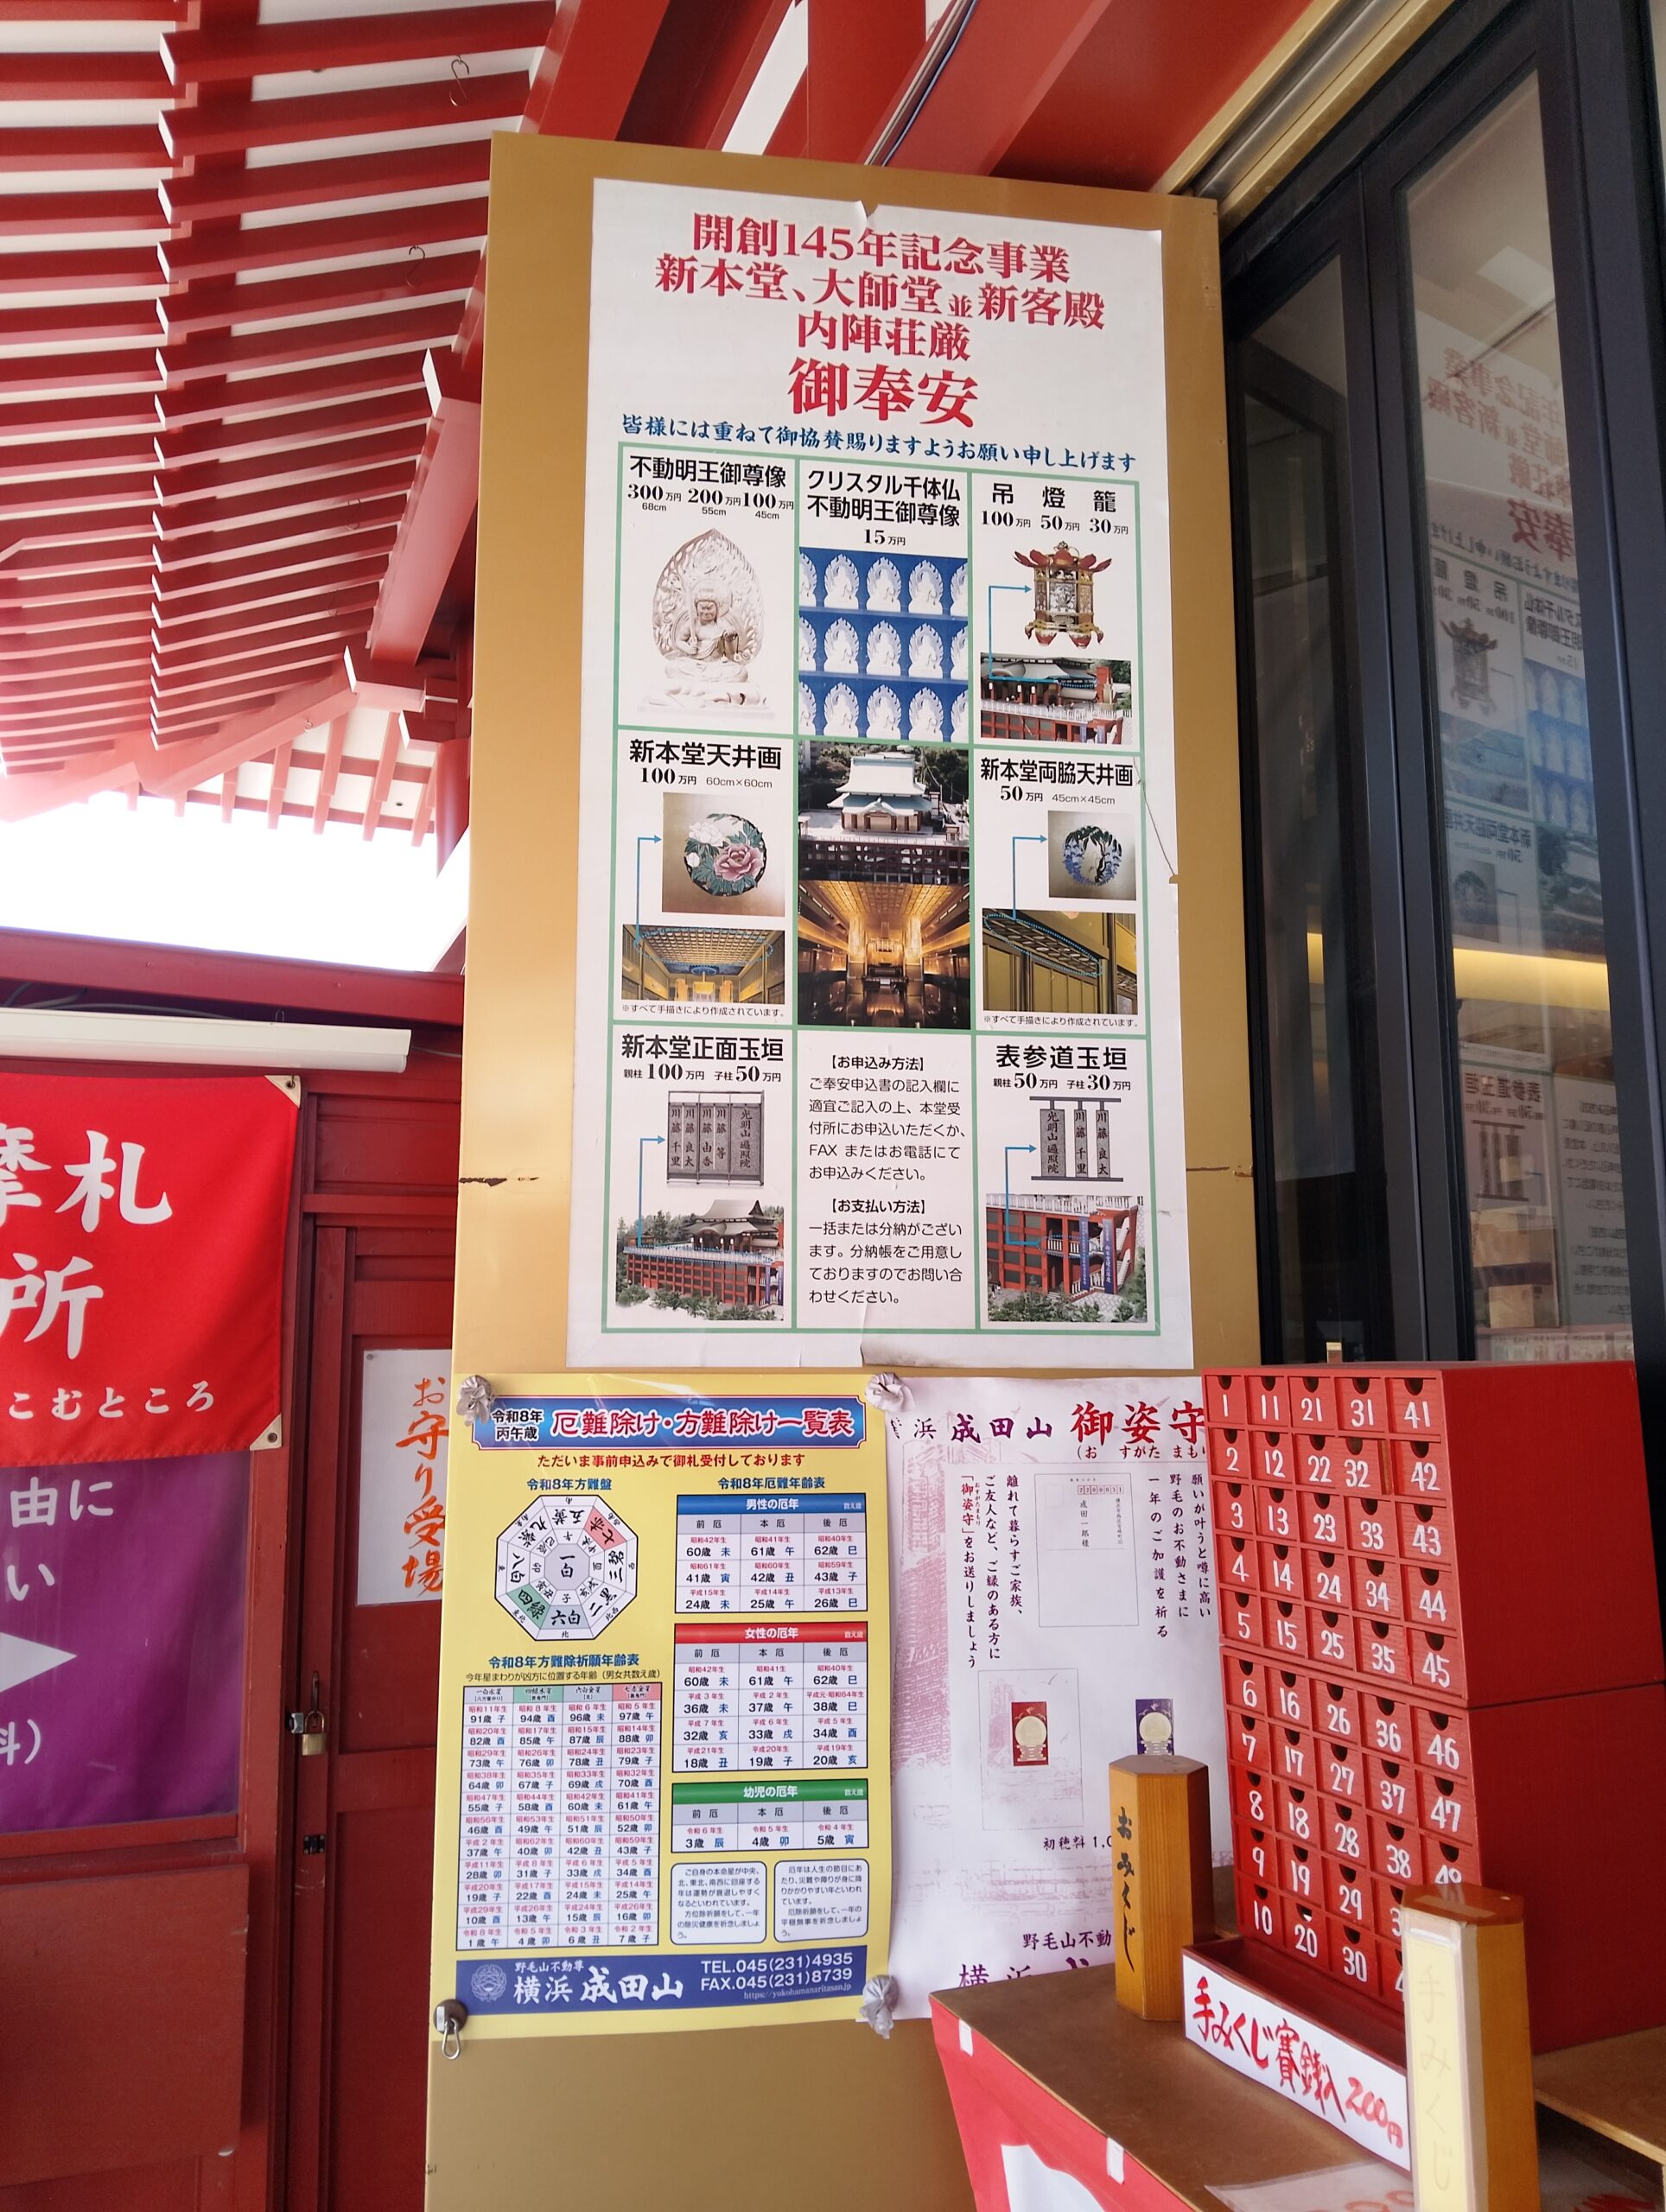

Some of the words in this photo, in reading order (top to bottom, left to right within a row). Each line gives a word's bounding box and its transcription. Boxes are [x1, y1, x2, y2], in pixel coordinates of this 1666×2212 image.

[693, 213, 1071, 283] 開創145年記念事業
[656, 253, 1105, 330] 新本堂、大師堂並新客殿
[798, 312, 971, 362] 内陣荘厳
[787, 356, 978, 429] 御奉安
[622, 414, 1136, 473] 皆様には重ねて御協賛賜りますようお願い申し上げます
[629, 455, 786, 488] 不動明王御尊像
[808, 469, 961, 502] クリスタル千体仏
[642, 503, 667, 512] 68cm
[702, 506, 727, 516] 55cm
[755, 511, 779, 520] 45cm
[807, 494, 960, 527] 不動明王御尊像
[629, 739, 782, 770] 新本堂天井画
[980, 757, 1133, 787] 新本堂両脇天井画
[622, 1003, 784, 1018] ※すべて手描きにより作成されています。
[983, 1014, 1138, 1028] ※すべて手描きにより作成されています。
[621, 1033, 784, 1062] 新本堂正面玉垣
[995, 1044, 1128, 1071] 表参道玉垣
[831, 1054, 925, 1071] 【お申込み方法】
[810, 1077, 960, 1093] ご奉安申込書の記入欄に
[809, 1098, 961, 1116] 適宜ご記入の上、本堂受
[809, 1121, 965, 1138] 付所にお申込いただくか、
[809, 1143, 837, 1157] FAX
[844, 1144, 961, 1160] またはお電話にて
[809, 1166, 926, 1181] お申込みください。
[831, 1198, 925, 1215] 【お支払い方法】
[809, 1220, 963, 1237] 一括または分納がござい
[809, 1243, 963, 1260] ます。分納帳をご用意し
[809, 1266, 963, 1282] ておりますのでお問い合
[809, 1289, 900, 1305] わせください。
[492, 1409, 544, 1424] 令和8年
[1223, 1395, 1228, 1417] 1
[1261, 1395, 1279, 1421] 11
[1301, 1398, 1322, 1421] 21
[1351, 1399, 1374, 1427] 31
[1404, 1401, 1430, 1428] 41
[496, 1426, 537, 1440] 丙午歳
[552, 1408, 854, 1438] 厄難除け・方難除け一覧表
[951, 1414, 1052, 1443] 成田山
[537, 1452, 805, 1469] ただいま事前申込みで御札受付しております
[1226, 1447, 1240, 1471] 2
[1264, 1450, 1285, 1478] 12
[1307, 1455, 1332, 1483] 22
[526, 1478, 612, 1491] 令和8年方難盤
[718, 1477, 825, 1490] 令和8年厄難年齢表
[1344, 1459, 1370, 1488] 32
[1410, 1462, 1440, 1491] 42
[747, 1498, 799, 1510] 男性の厄年
[1230, 1503, 1243, 1529] 3
[1006, 1474, 1022, 1615] 離れて暮らすご家族、
[1169, 1473, 1189, 1618] 野毛のお不動さまに
[1191, 1473, 1211, 1618] 願いが叶うと噂に高い
[1412, 1524, 1441, 1556] 43
[984, 1475, 1000, 1659] ご友人など、ご縁のある方に
[1148, 1476, 1168, 1638] 一年のご加護を祈る
[1232, 1554, 1249, 1582] 4
[961, 1476, 976, 1669] 「御姿守」をお送りしましょう
[1419, 1590, 1447, 1622] 44
[744, 1627, 798, 1639] 女性の厄年
[1237, 1611, 1250, 1639] 5
[1277, 1620, 1297, 1650] 15
[1321, 1630, 1344, 1660] 25
[1371, 1643, 1396, 1674] 35
[488, 1654, 639, 1669] 令和8年方難除祈願年齢表
[1422, 1652, 1450, 1688] 45
[1243, 1680, 1257, 1707] 6
[743, 1785, 798, 1798] 幼児の厄年
[1431, 1796, 1461, 1833] 47
[1386, 1844, 1412, 1878] 38
[1254, 1901, 1273, 1936] 10
[1023, 1929, 1112, 1951] 野毛山不動
[1294, 1923, 1318, 1959] 20
[514, 1960, 584, 1973] 野毛山不動尊
[700, 1952, 853, 1974] TEL.045(231)4935
[1342, 1947, 1368, 1983] 30
[513, 1975, 573, 2004] 横浜
[580, 1965, 684, 2004] 成田山
[700, 1967, 852, 1992] FAX.045(231)8739
